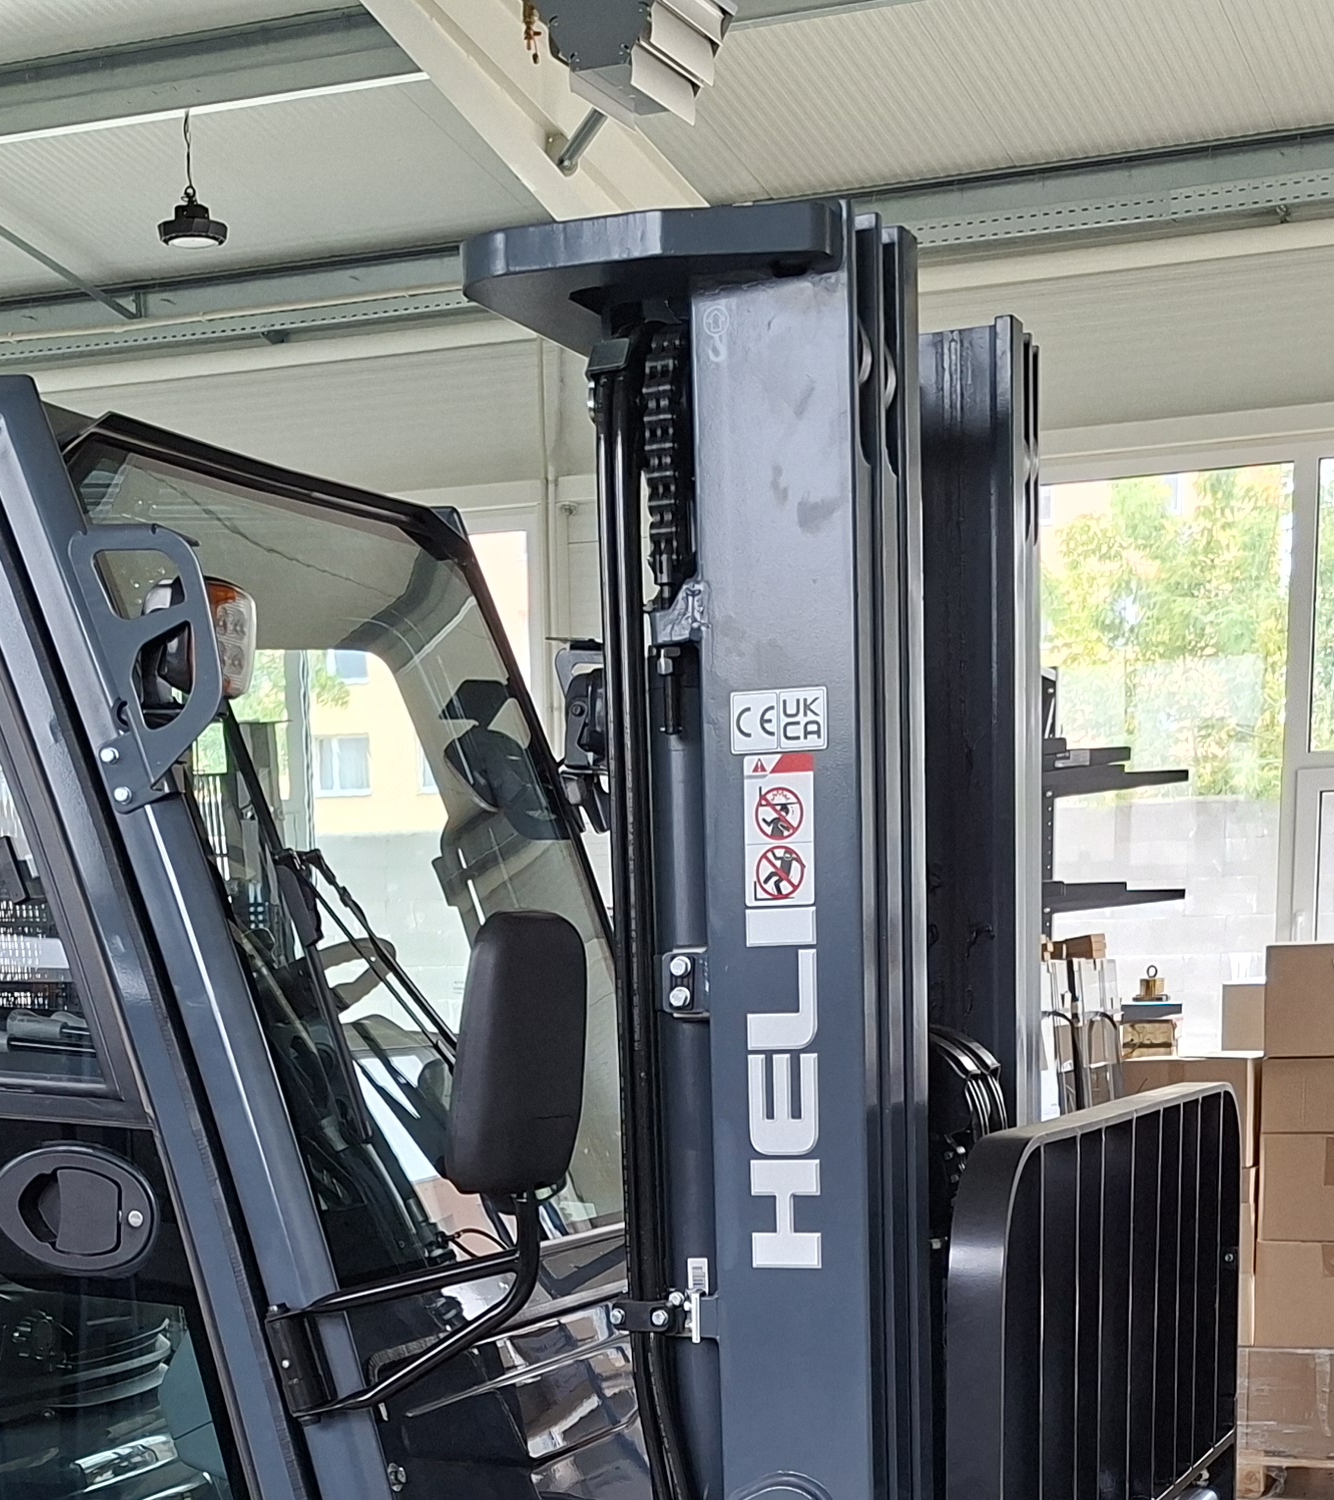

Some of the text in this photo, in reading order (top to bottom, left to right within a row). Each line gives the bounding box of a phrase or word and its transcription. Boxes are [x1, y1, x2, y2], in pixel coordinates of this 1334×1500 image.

[782, 697, 820, 718] UK
[782, 721, 821, 741] CA
[746, 907, 822, 1269] HELI
